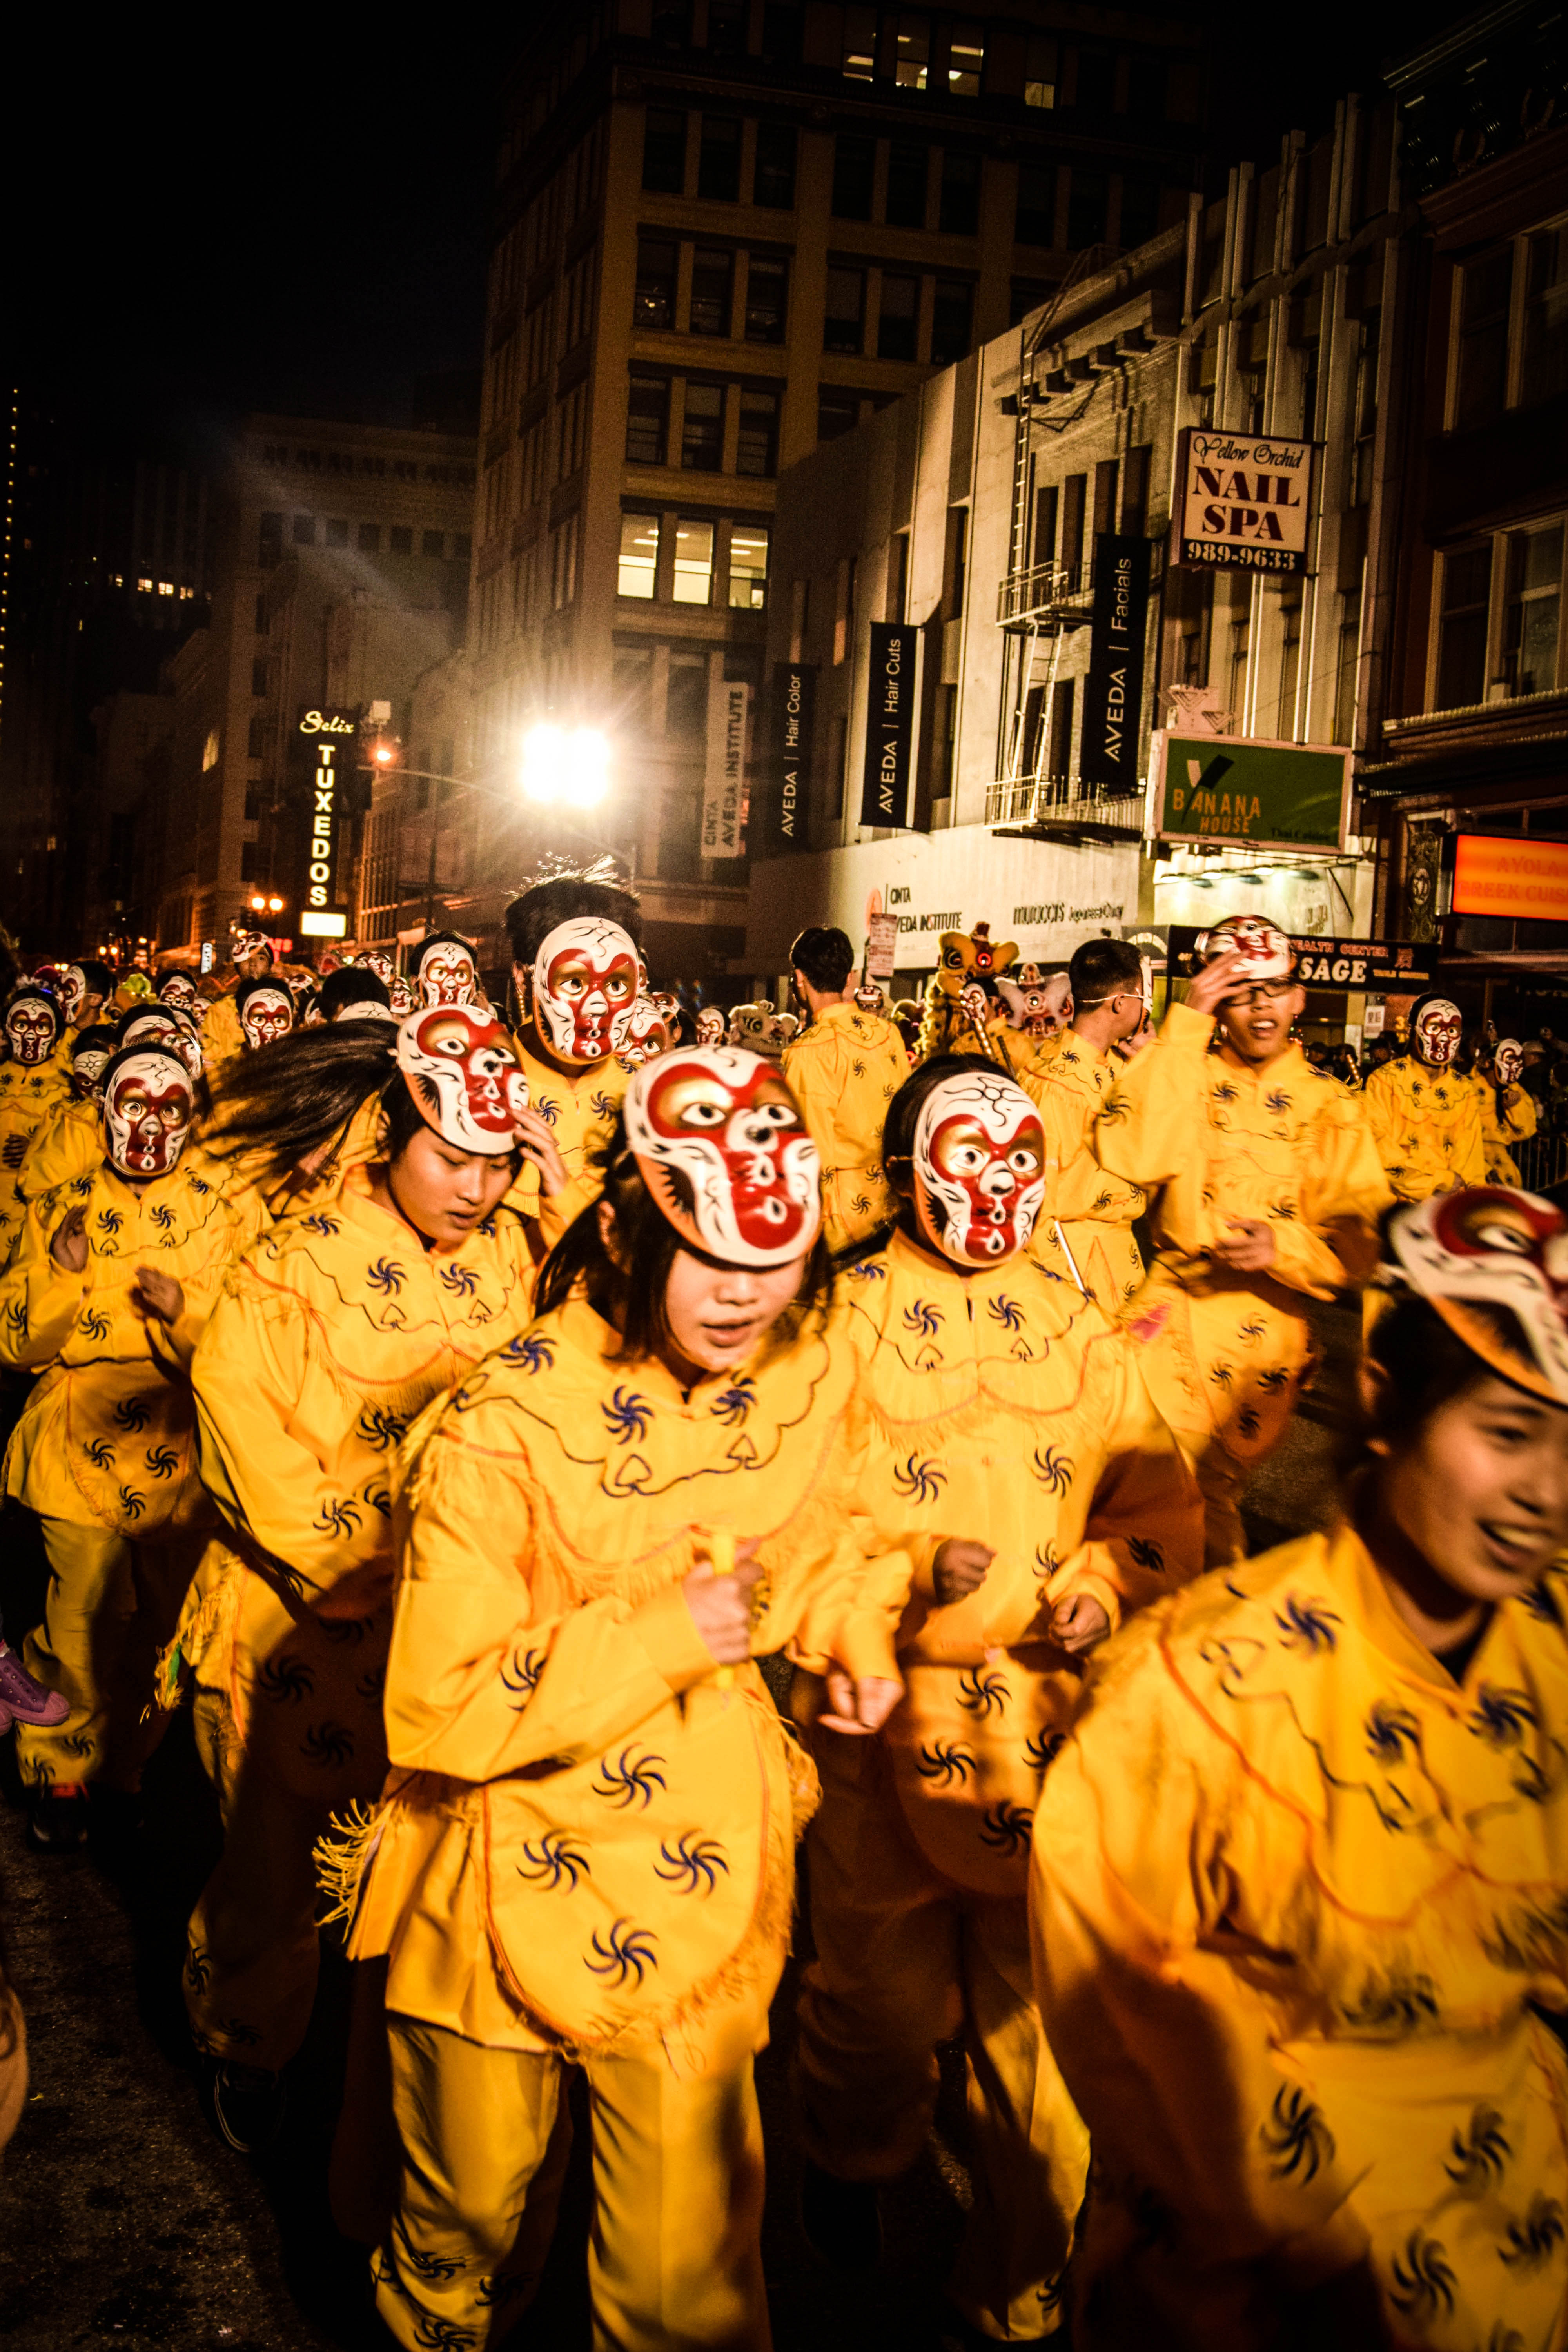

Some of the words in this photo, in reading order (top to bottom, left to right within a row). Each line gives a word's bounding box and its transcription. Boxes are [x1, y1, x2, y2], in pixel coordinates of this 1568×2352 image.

[1193, 436, 1249, 463] Yellow
[1253, 443, 1304, 468] Orchid
[1192, 466, 1301, 507] NAIL
[1202, 504, 1284, 541] SPA
[1187, 541, 1296, 570] 989-9633
[1111, 558, 1132, 632] Facials
[886, 638, 902, 675] Cuts
[787, 674, 802, 713] Color
[884, 680, 900, 712] Hair
[299, 710, 355, 734] Selix
[1103, 667, 1127, 762] AVEDA
[724, 690, 743, 779] INSTITUTE
[785, 716, 799, 748] Hair
[878, 740, 898, 814] AVEDA
[720, 786, 738, 848] AVEDA
[780, 771, 798, 837] AVEDA
[1173, 788, 1261, 818] BANANA
[309, 744, 336, 907] TUXEDOS
[1200, 816, 1250, 834] HOUSE
[1497, 856, 1559, 876] AYOLA
[1457, 881, 1519, 900] GREEK
[920, 911, 962, 931] INSTITUTE
[1340, 943, 1388, 958] CENTER
[1298, 956, 1367, 984] SAGE
